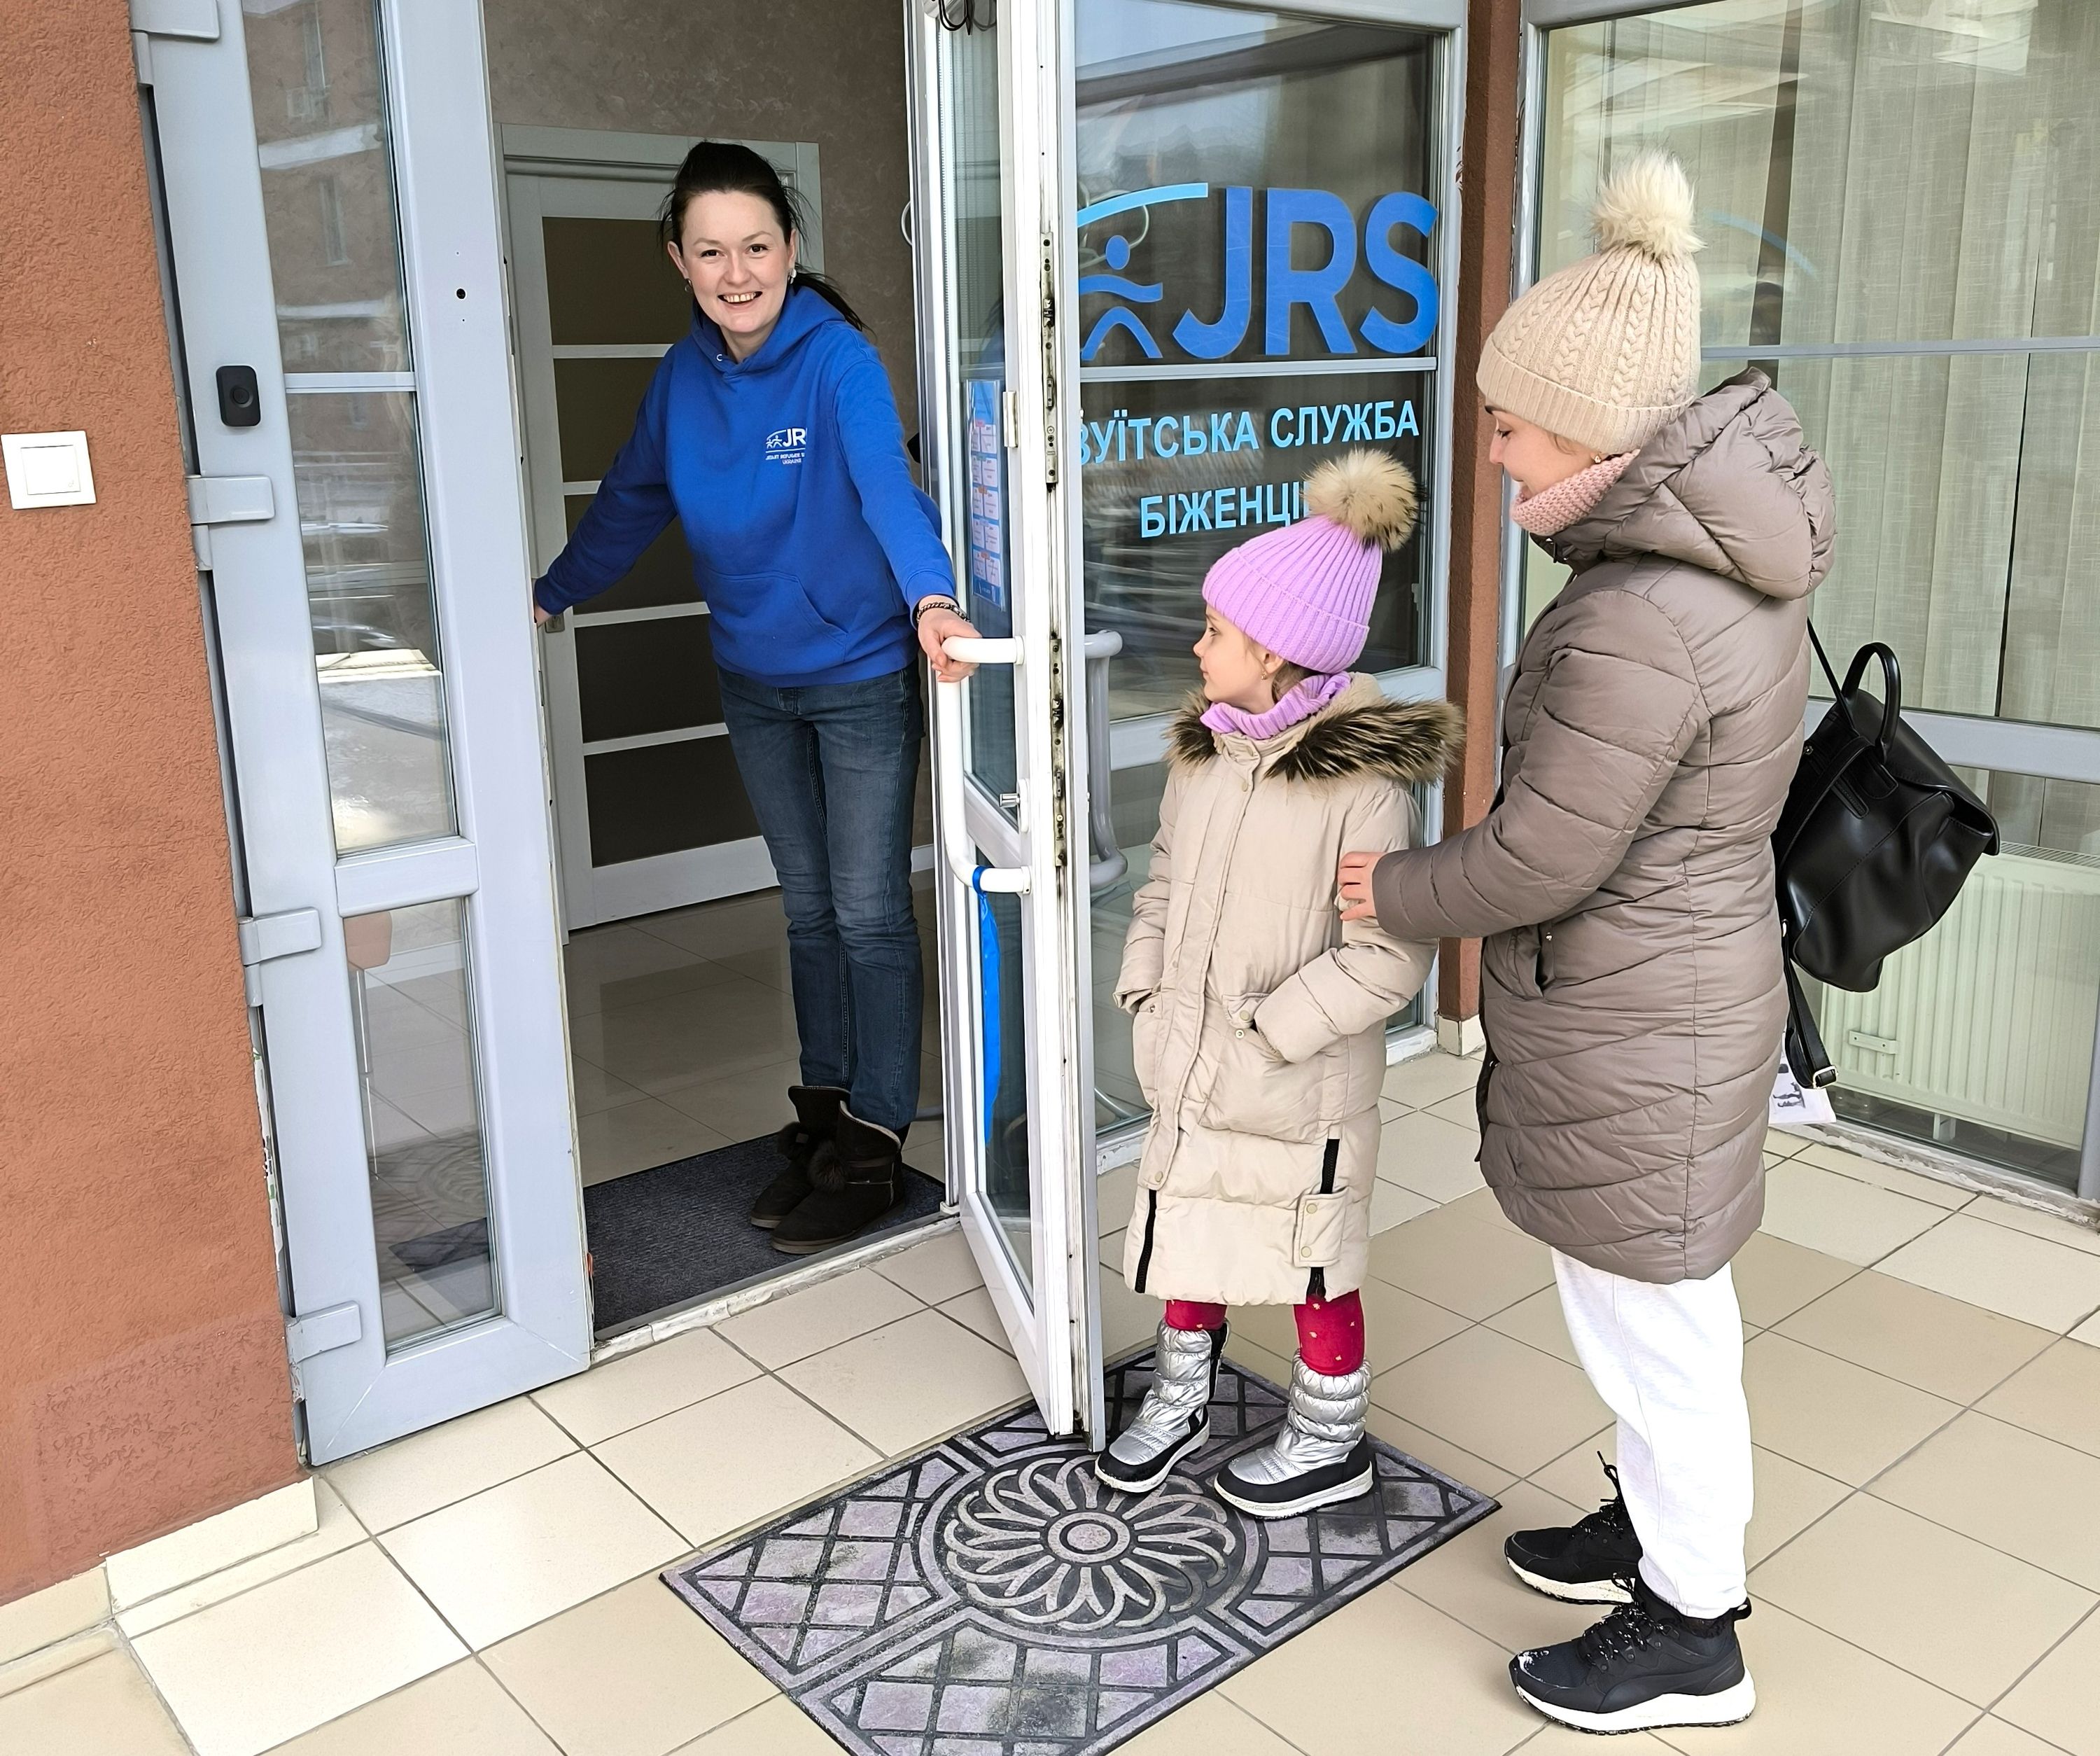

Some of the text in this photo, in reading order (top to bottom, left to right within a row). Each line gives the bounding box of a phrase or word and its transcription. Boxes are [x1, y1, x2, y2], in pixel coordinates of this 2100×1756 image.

[1172, 186, 1438, 358] JRS
[783, 428, 807, 447] JR
[1270, 400, 1420, 448] СЛУЖБА
